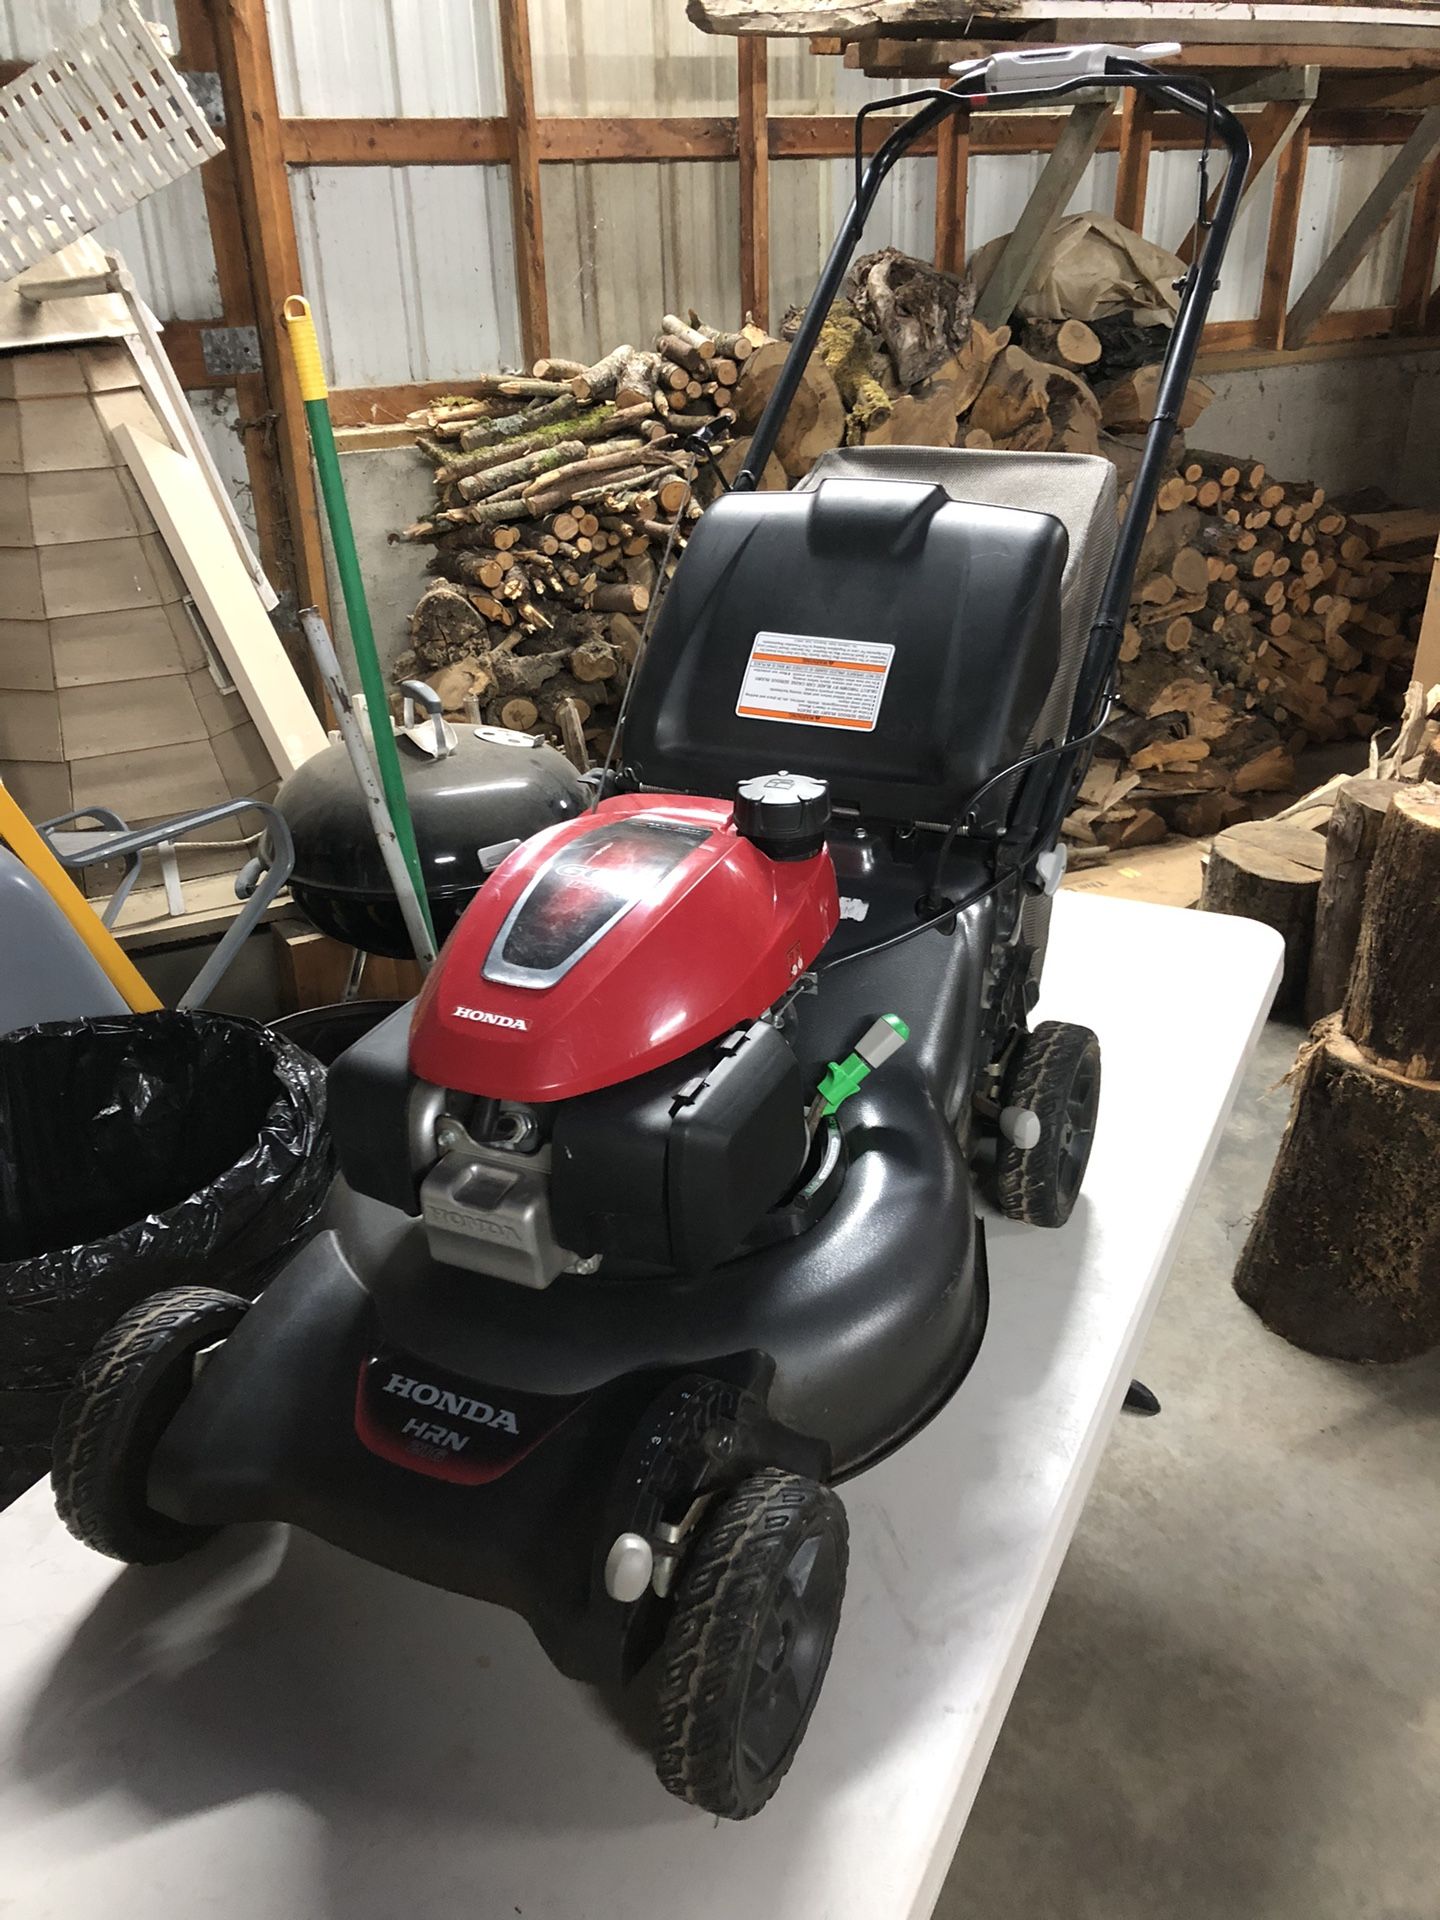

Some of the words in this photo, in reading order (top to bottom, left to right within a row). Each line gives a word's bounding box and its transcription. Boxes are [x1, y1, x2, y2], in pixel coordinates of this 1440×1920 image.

[452, 1006, 528, 1031] HONDA
[427, 1205, 523, 1241] HONDA
[382, 1373, 520, 1434] HONDA
[401, 1417, 470, 1452] HRN
[651, 1435, 662, 1446] 3
